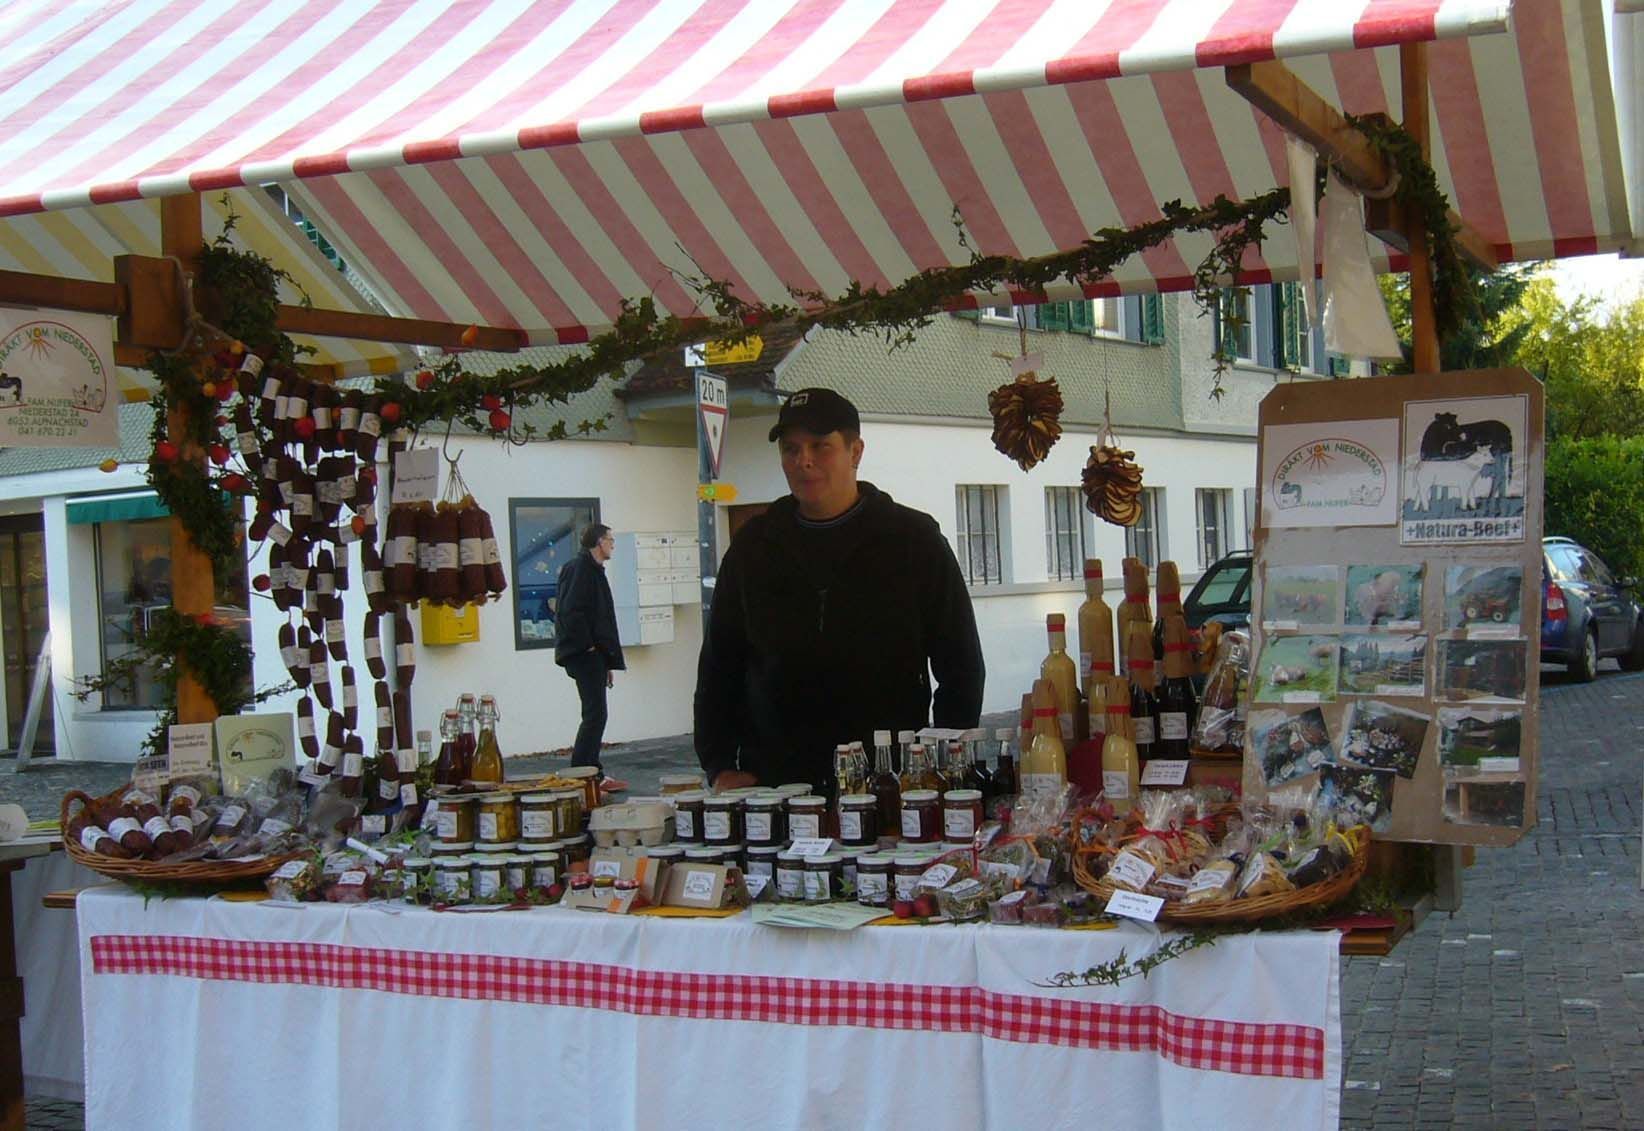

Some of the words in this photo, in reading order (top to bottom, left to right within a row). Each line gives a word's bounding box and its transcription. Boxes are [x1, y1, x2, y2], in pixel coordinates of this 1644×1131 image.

[702, 379, 715, 402] 20
[716, 388, 725, 405] m
[1335, 443, 1382, 476] NIEDERSTAD
